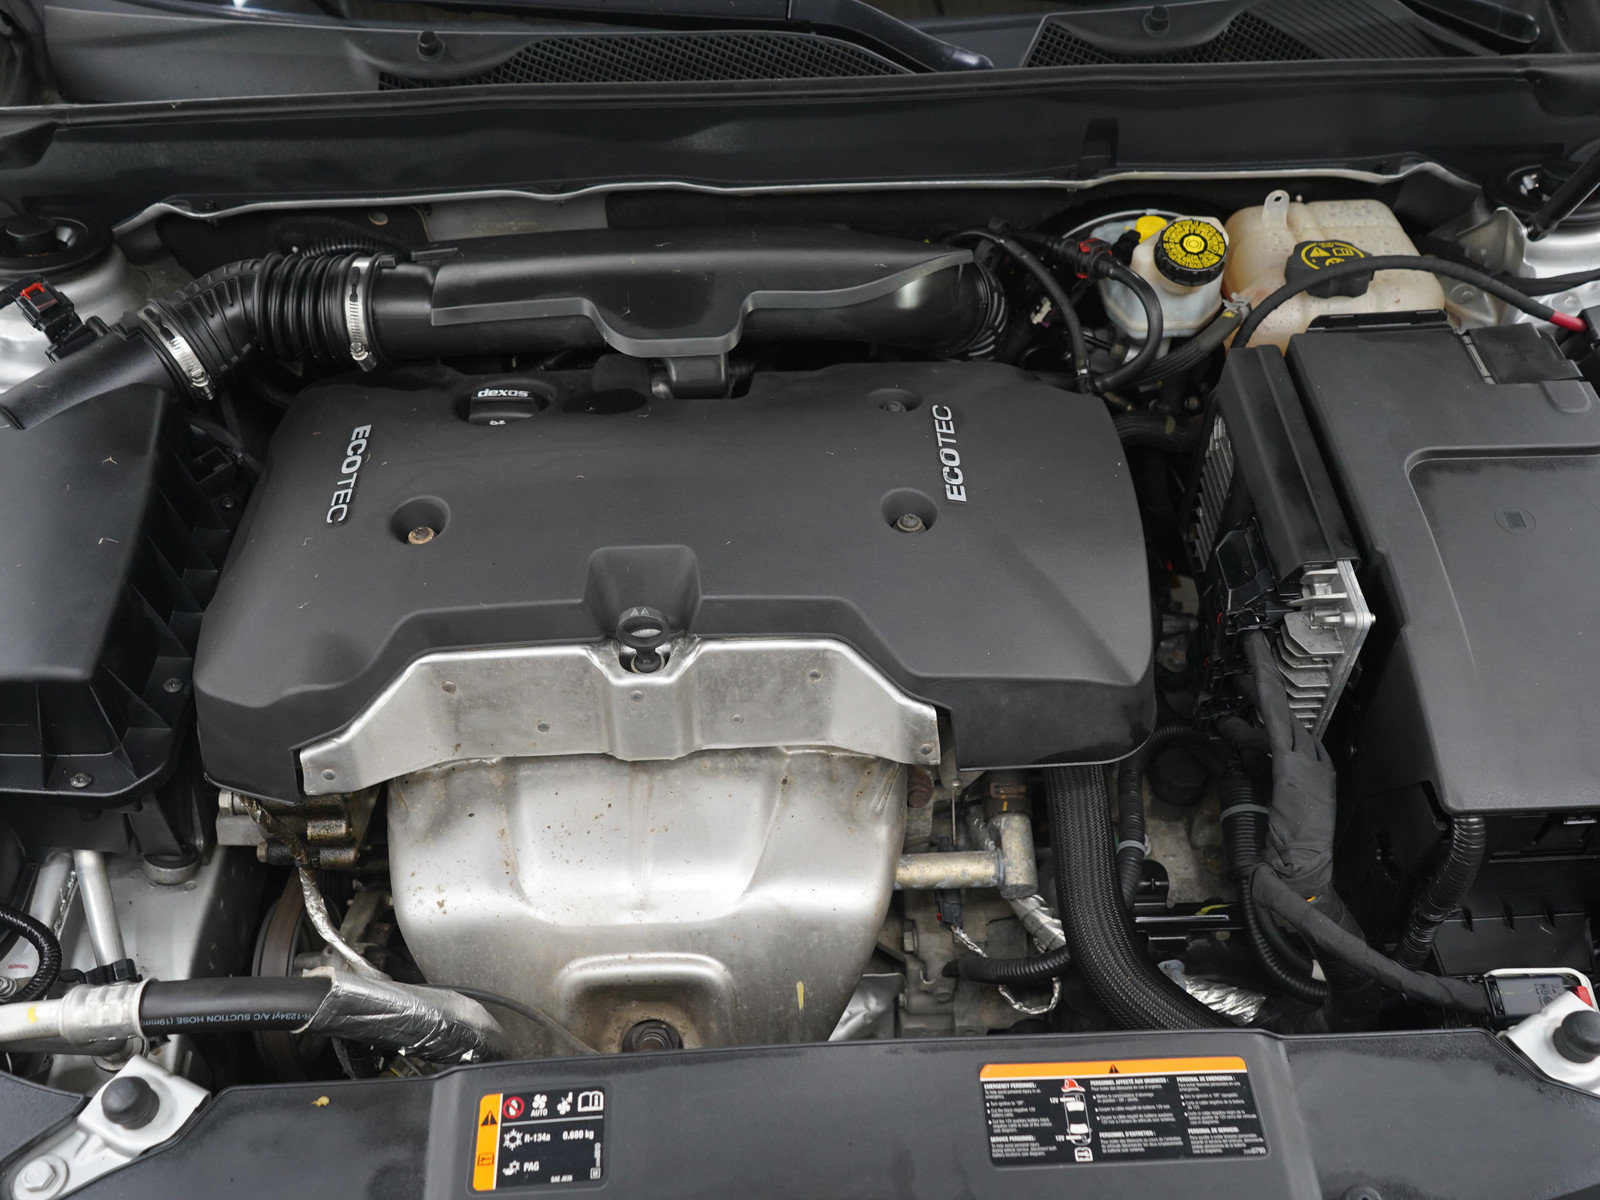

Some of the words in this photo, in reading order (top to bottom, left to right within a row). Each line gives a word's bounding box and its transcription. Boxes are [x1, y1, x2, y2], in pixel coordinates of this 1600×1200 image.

[477, 388, 530, 398] dexos
[931, 404, 967, 502] ECOTEC
[326, 424, 372, 525] ECOTEC
[177, 1016, 203, 1024] HOSE
[207, 1013, 250, 1022] SUCTION
[253, 1012, 270, 1020] A/C
[272, 1012, 311, 1020] R-1234yf
[530, 1109, 548, 1117] AUTO
[524, 1133, 551, 1143] R-134a
[585, 1129, 594, 1140] kg
[523, 1161, 540, 1172] PAG
